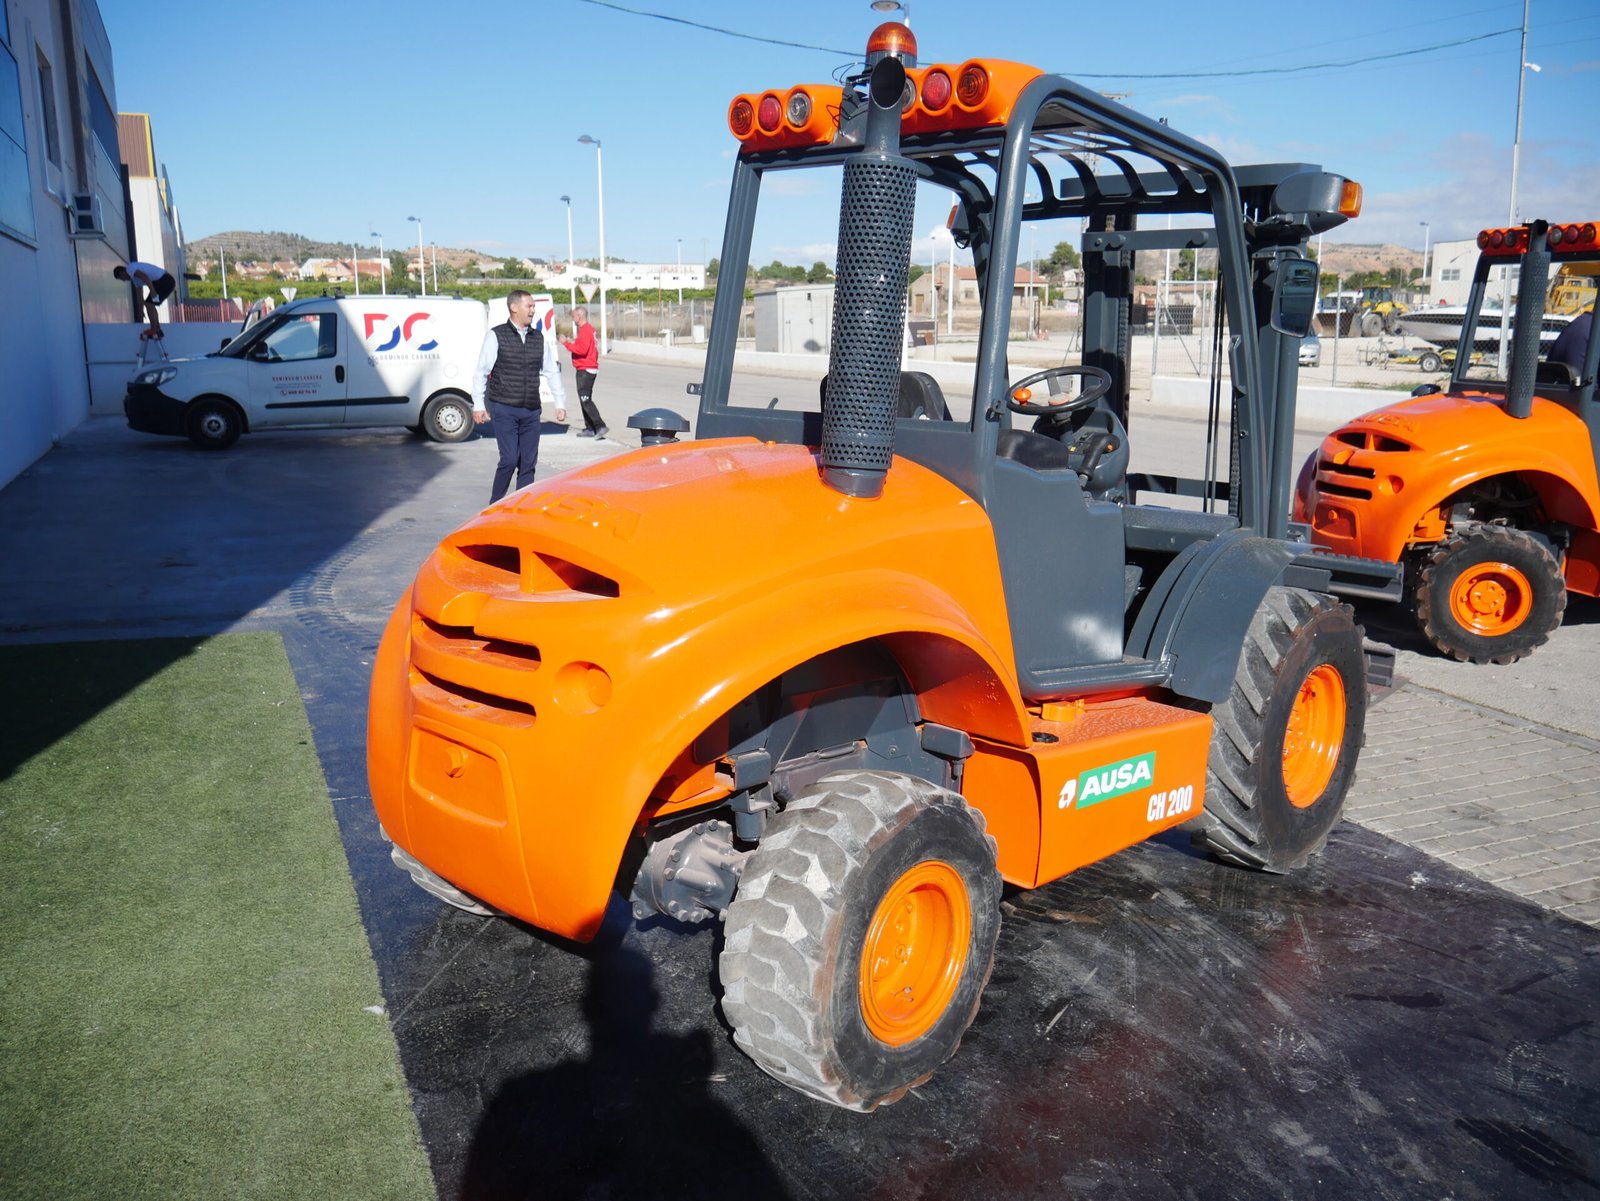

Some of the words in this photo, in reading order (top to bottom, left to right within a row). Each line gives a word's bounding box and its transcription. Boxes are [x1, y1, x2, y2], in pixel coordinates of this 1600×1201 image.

[1079, 759, 1152, 801] AUSA
[1146, 791, 1167, 823] CH
[1166, 784, 1194, 818] 200
